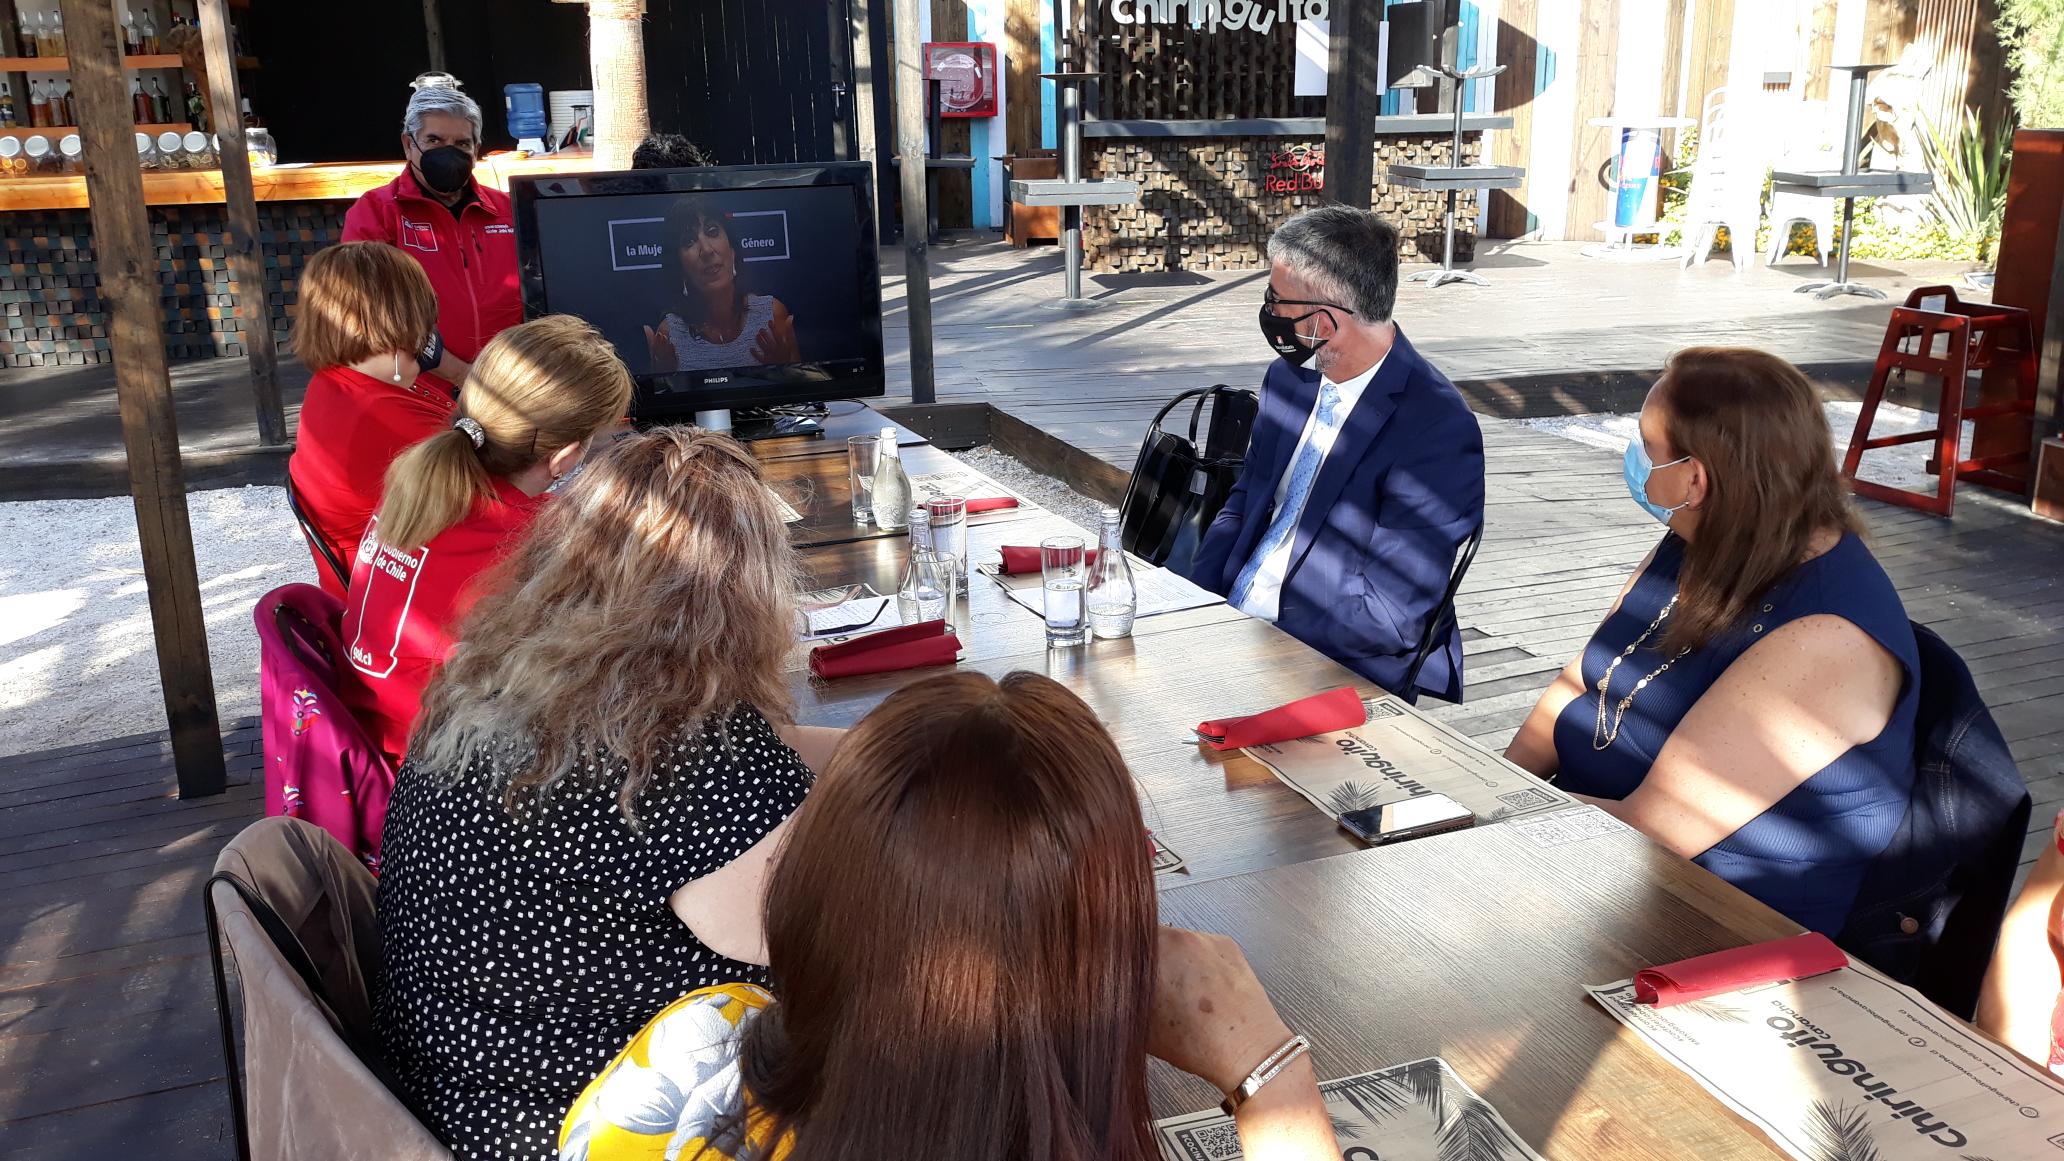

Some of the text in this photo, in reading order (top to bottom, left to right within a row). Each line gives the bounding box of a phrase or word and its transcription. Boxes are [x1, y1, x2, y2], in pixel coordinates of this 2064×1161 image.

[1265, 173, 1325, 191] Red Bu
[638, 244, 662, 257] Muje
[741, 238, 775, 249] Género
[704, 376, 728, 385] PHILIPS
[376, 555, 407, 582] de Chile
[1336, 739, 1432, 797] hiringuito
[1771, 1000, 1831, 1040] cavancha
[1766, 1016, 1968, 1148] chiringuito
